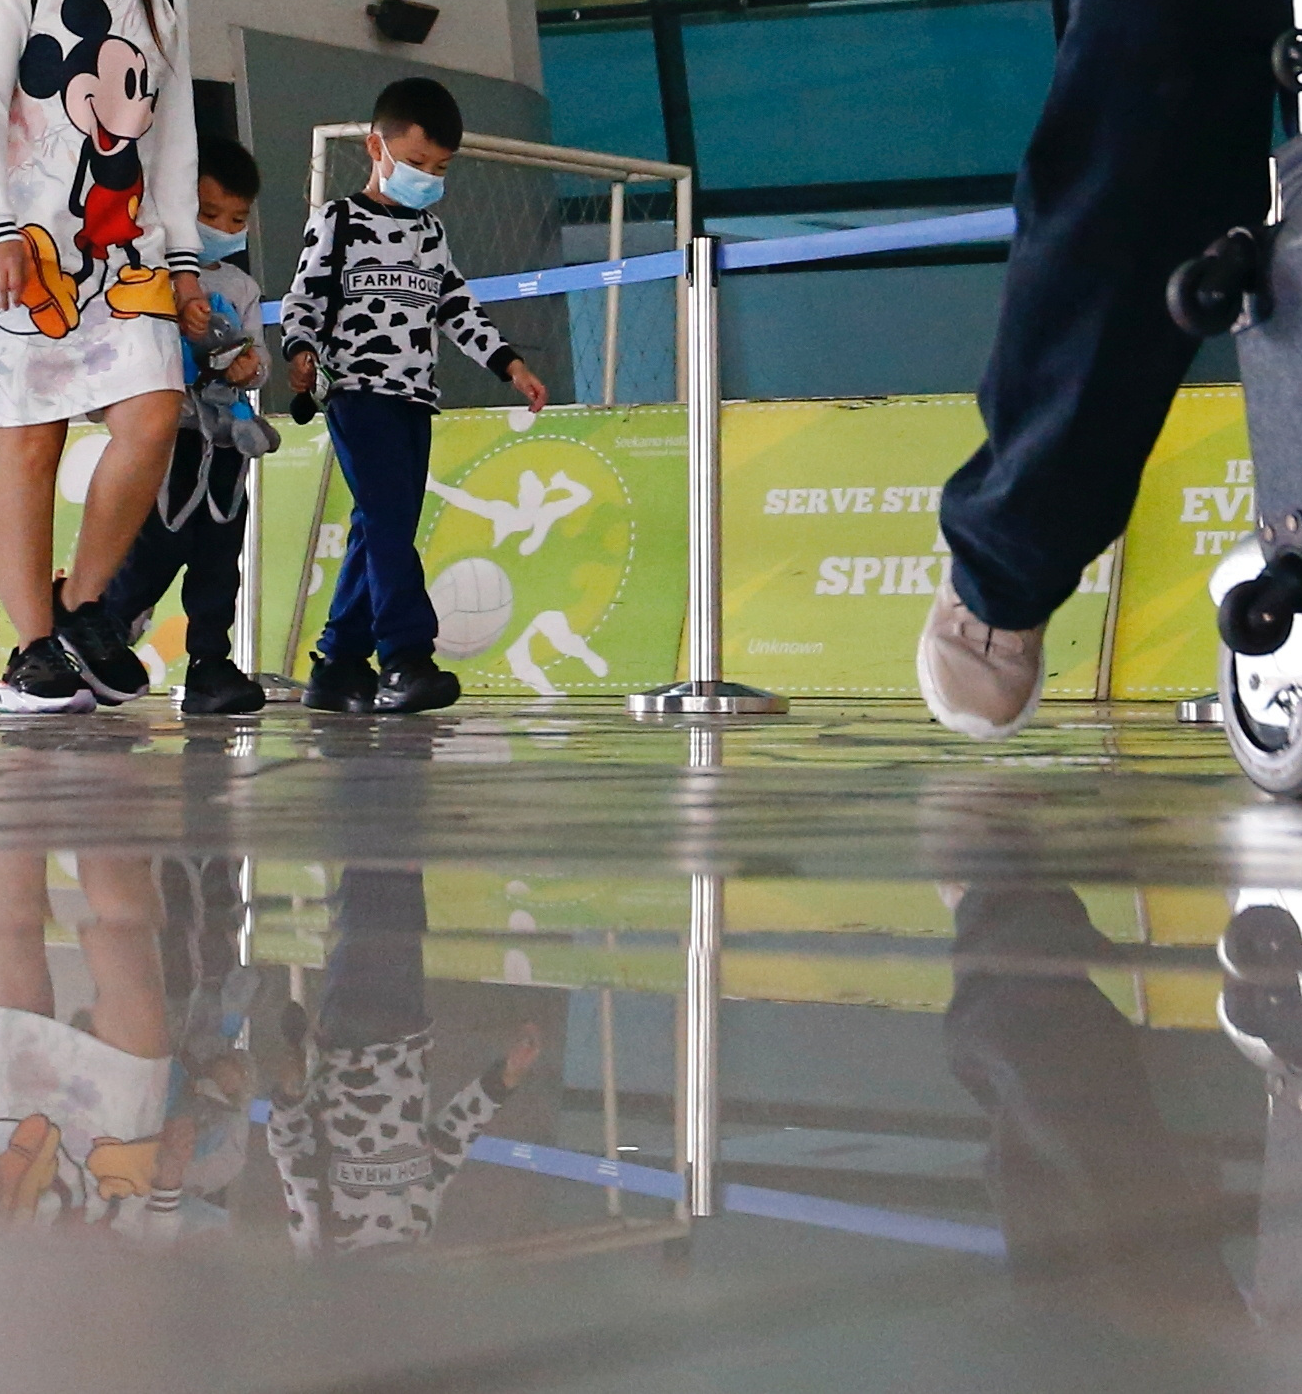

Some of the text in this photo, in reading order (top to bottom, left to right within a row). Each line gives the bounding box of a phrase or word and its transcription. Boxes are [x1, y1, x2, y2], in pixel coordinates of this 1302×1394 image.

[353, 273, 440, 294] FARM HOUS
[763, 485, 945, 515] SERVE STR
[1180, 486, 1256, 523] EV
[1193, 530, 1252, 556] IT'
[747, 637, 824, 655] Unknown
